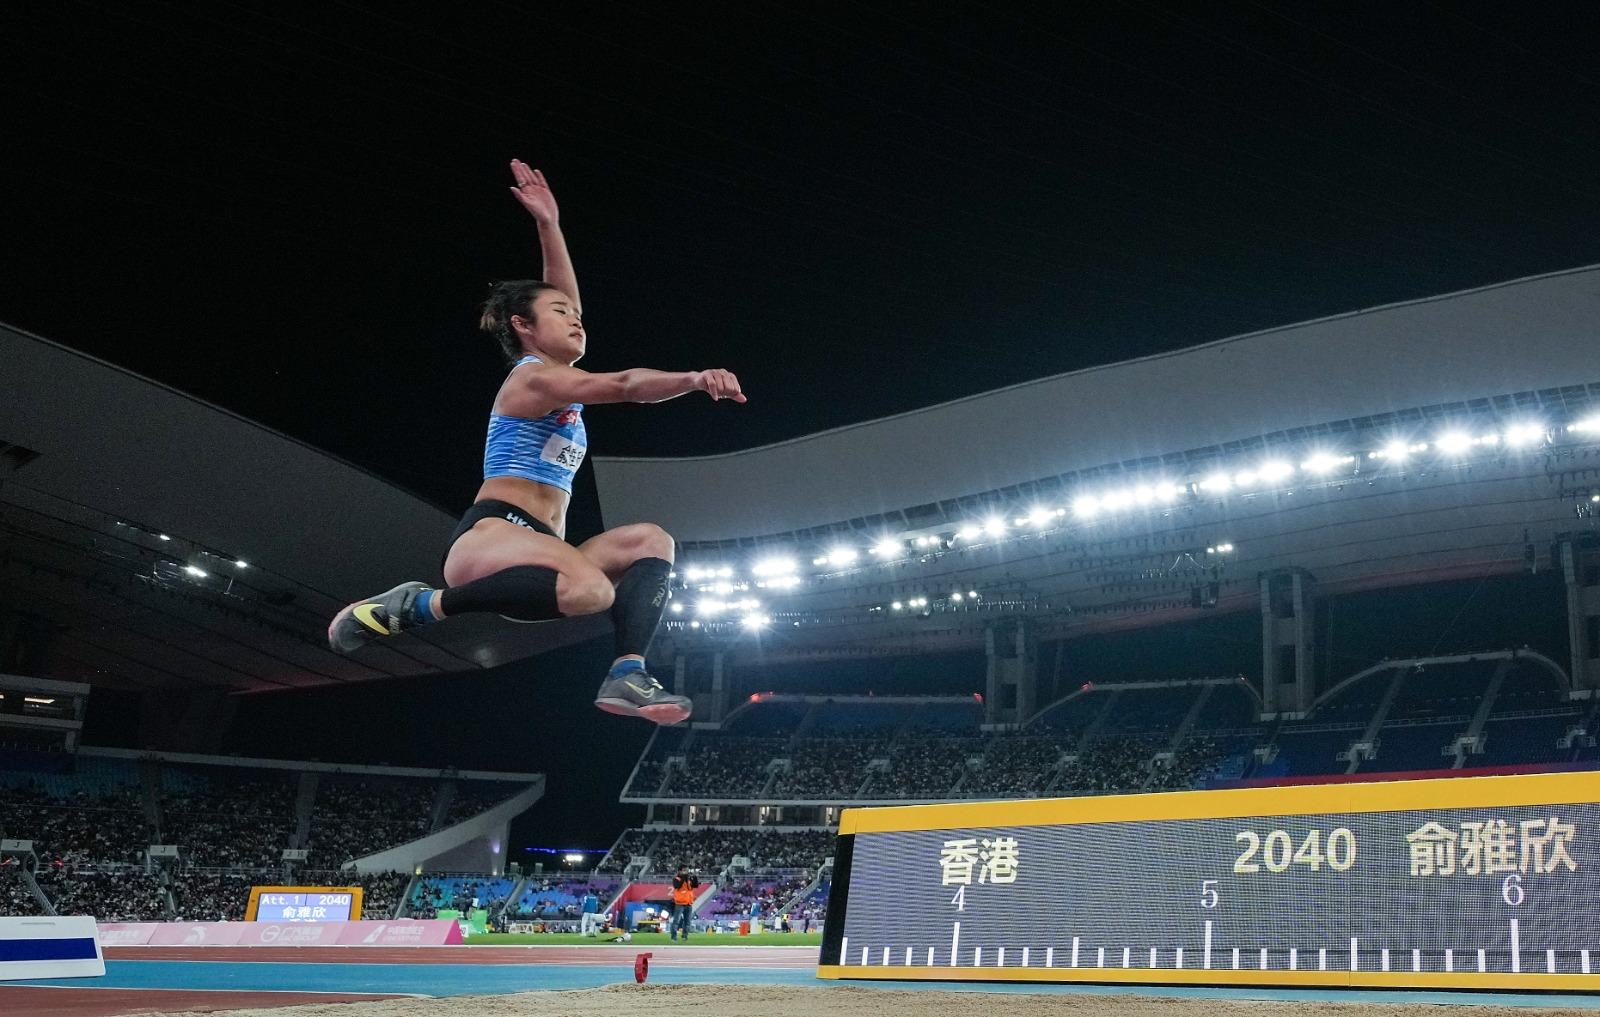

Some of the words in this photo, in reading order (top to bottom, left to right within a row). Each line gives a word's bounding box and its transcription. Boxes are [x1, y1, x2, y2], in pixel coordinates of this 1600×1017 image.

[939, 837, 1019, 885] 香港
[1233, 828, 1357, 873] 2040
[1406, 817, 1578, 876] 俞雅欣
[261, 895, 289, 905] Att.
[294, 895, 300, 905] 1
[319, 895, 349, 905] 2040
[951, 885, 967, 911] 4
[1200, 880, 1219, 908] 5
[1502, 875, 1525, 905] 6
[282, 906, 327, 918] 俞雅欣
